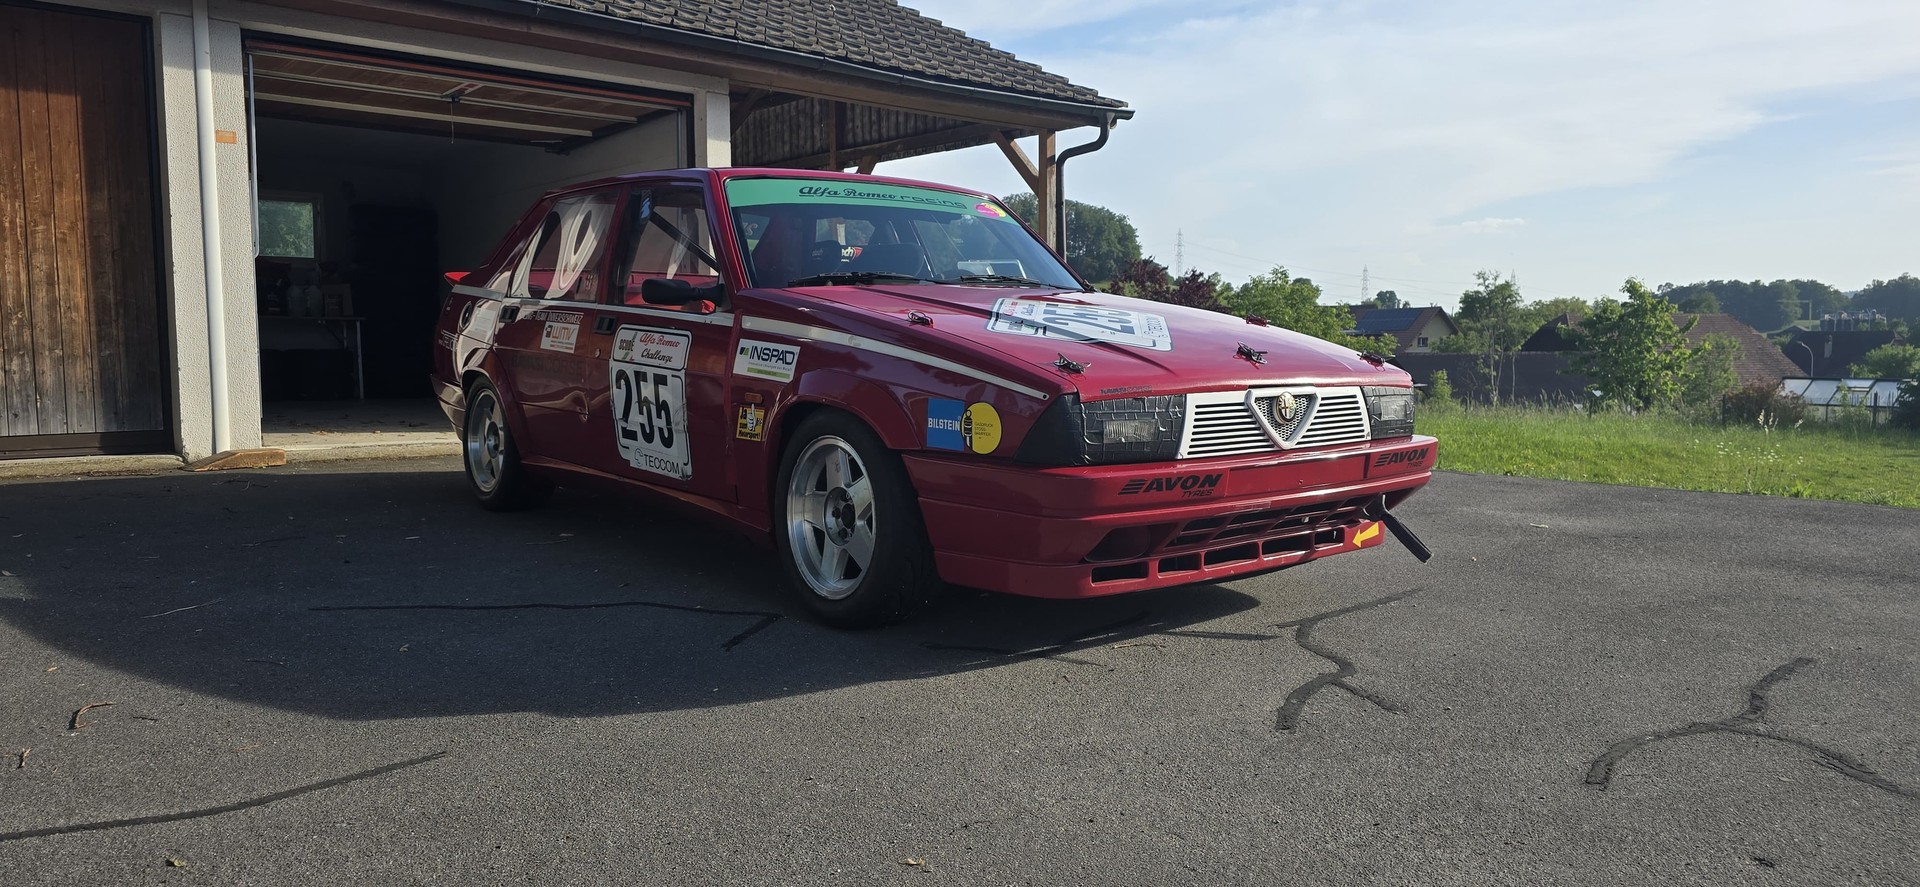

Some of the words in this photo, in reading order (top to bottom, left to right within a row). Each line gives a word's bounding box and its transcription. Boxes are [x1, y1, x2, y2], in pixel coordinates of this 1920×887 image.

[799, 187, 840, 197] Alfa
[843, 188, 896, 199] Romeo
[640, 333, 656, 346] Alfa
[656, 335, 680, 348] Romeo
[641, 348, 673, 364] Challenge
[749, 345, 796, 365] INSPAD
[615, 369, 674, 449] 255
[927, 417, 961, 431] BILSTEIN
[643, 454, 680, 475] TECCOM
[1387, 448, 1429, 465] AVON
[1143, 474, 1223, 493] AVON
[1181, 489, 1214, 498] TYRES
